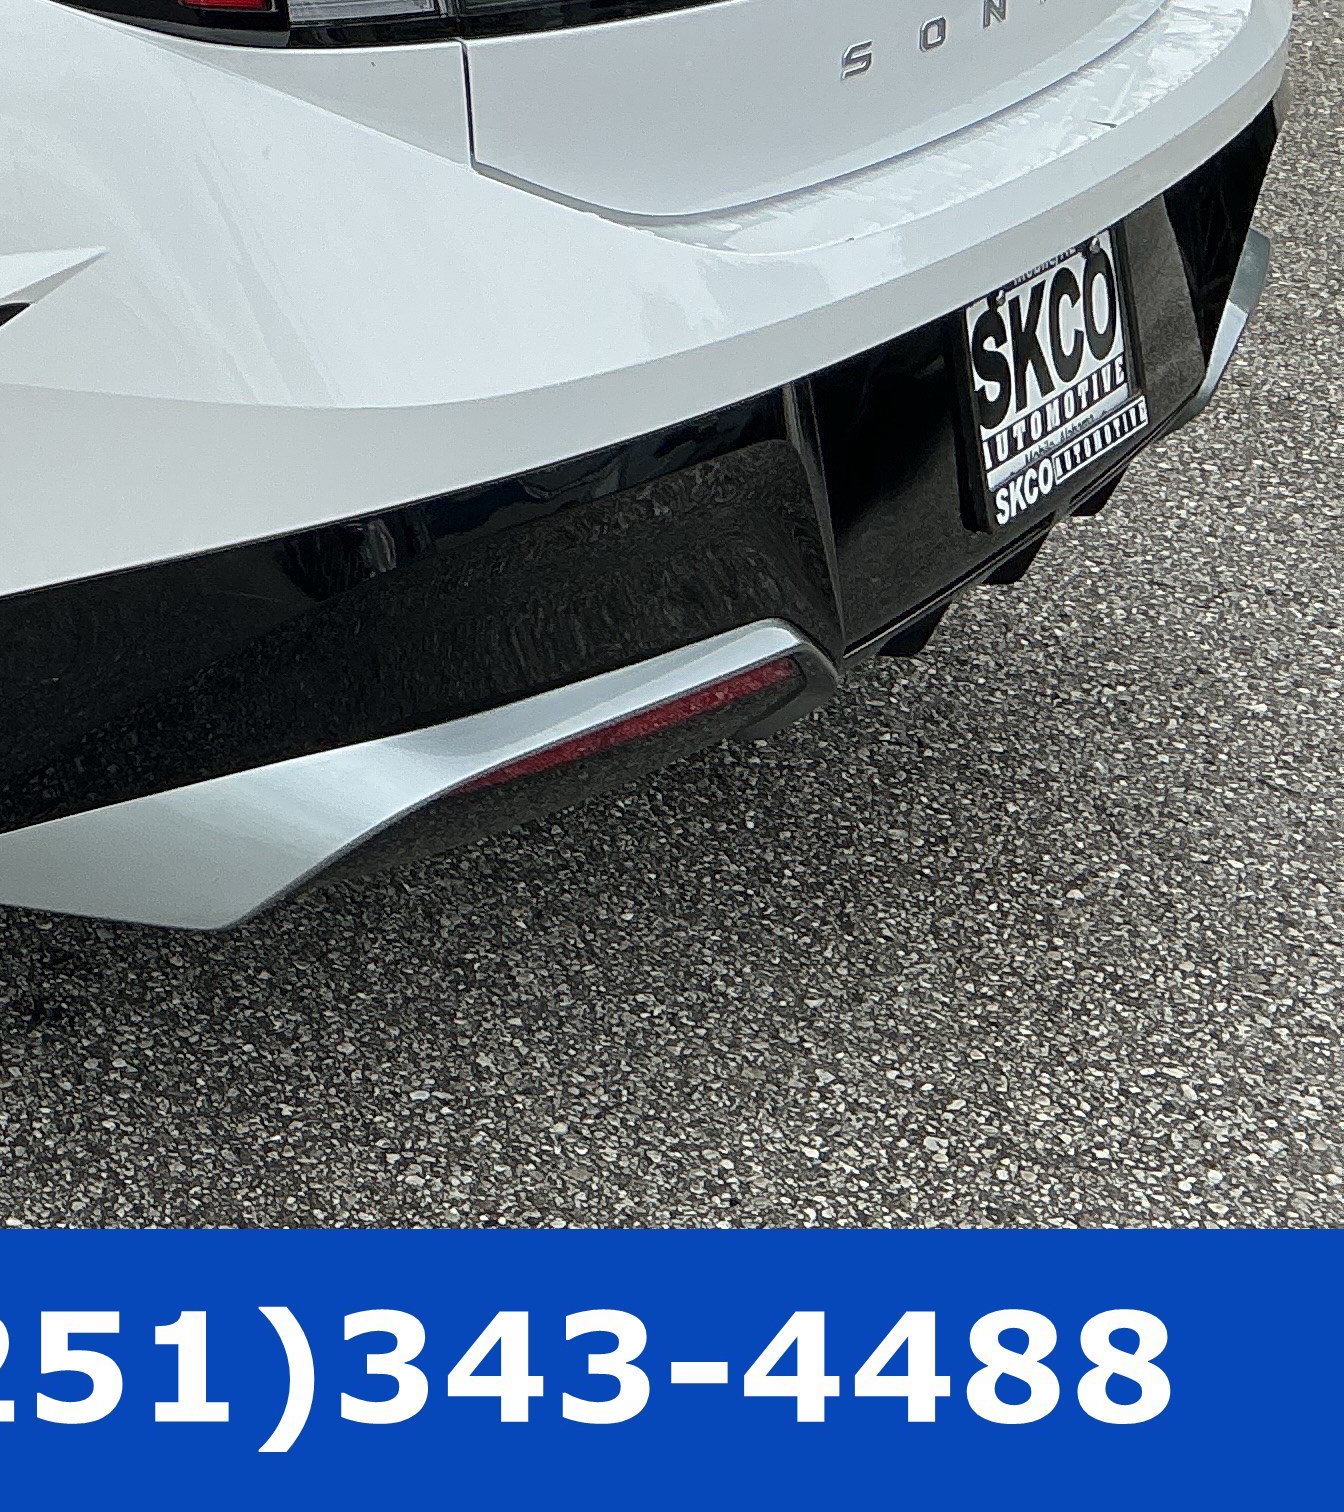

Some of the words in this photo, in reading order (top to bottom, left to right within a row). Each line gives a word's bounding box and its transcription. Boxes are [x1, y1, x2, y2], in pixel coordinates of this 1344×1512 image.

[972, 246, 1117, 430] SKCO
[996, 458, 1054, 526] SKCO
[1054, 397, 1147, 476] AUTOMOTIVE
